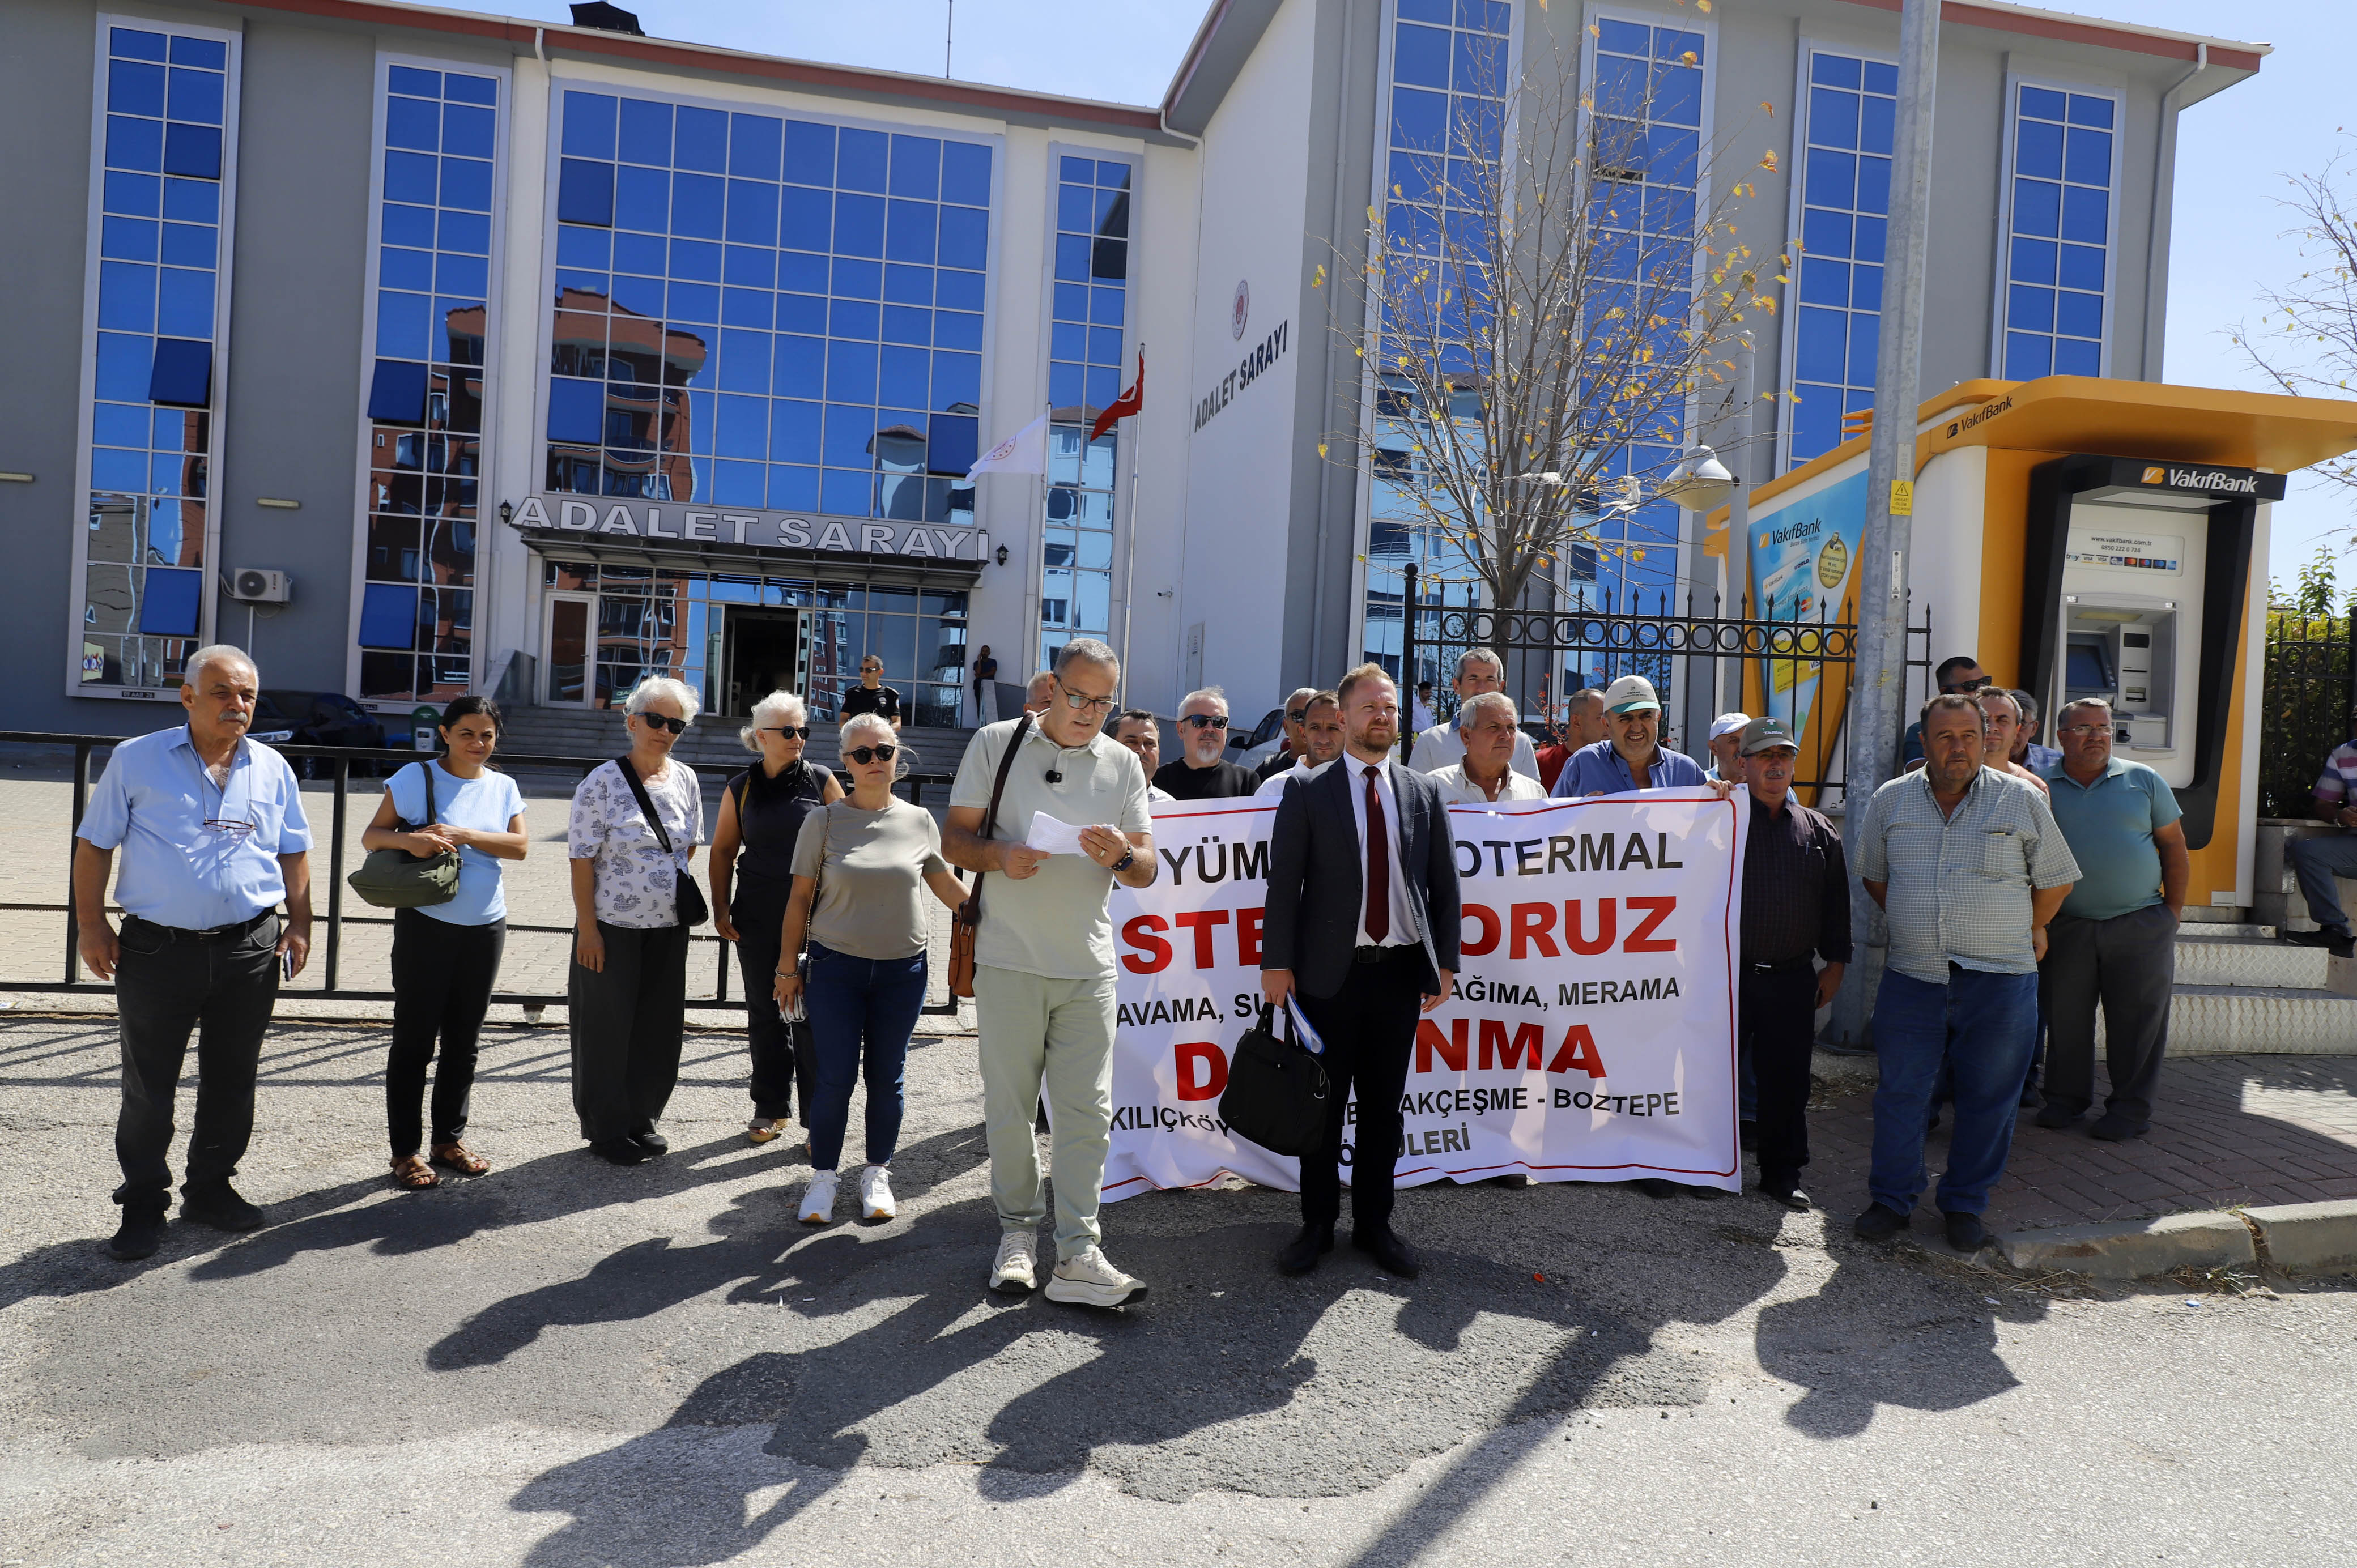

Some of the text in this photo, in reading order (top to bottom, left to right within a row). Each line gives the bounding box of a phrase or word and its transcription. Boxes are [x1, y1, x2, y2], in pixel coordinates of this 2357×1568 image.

[1194, 319, 1287, 433] ADALET SARAYI
[1961, 395, 2012, 431] VakıfBank
[2169, 468, 2258, 493] VakıfBank
[510, 496, 759, 544] ADALET
[1772, 518, 1822, 544] VakıfBank
[2091, 536, 2152, 546] www.vakifbank.com.tr
[1155, 836, 1270, 889] YÜM
[1558, 977, 1680, 1006] MERAMA
[1401, 1088, 1528, 1118] AKÇEŞME
[1554, 1088, 1680, 1117] BOZTEPE
